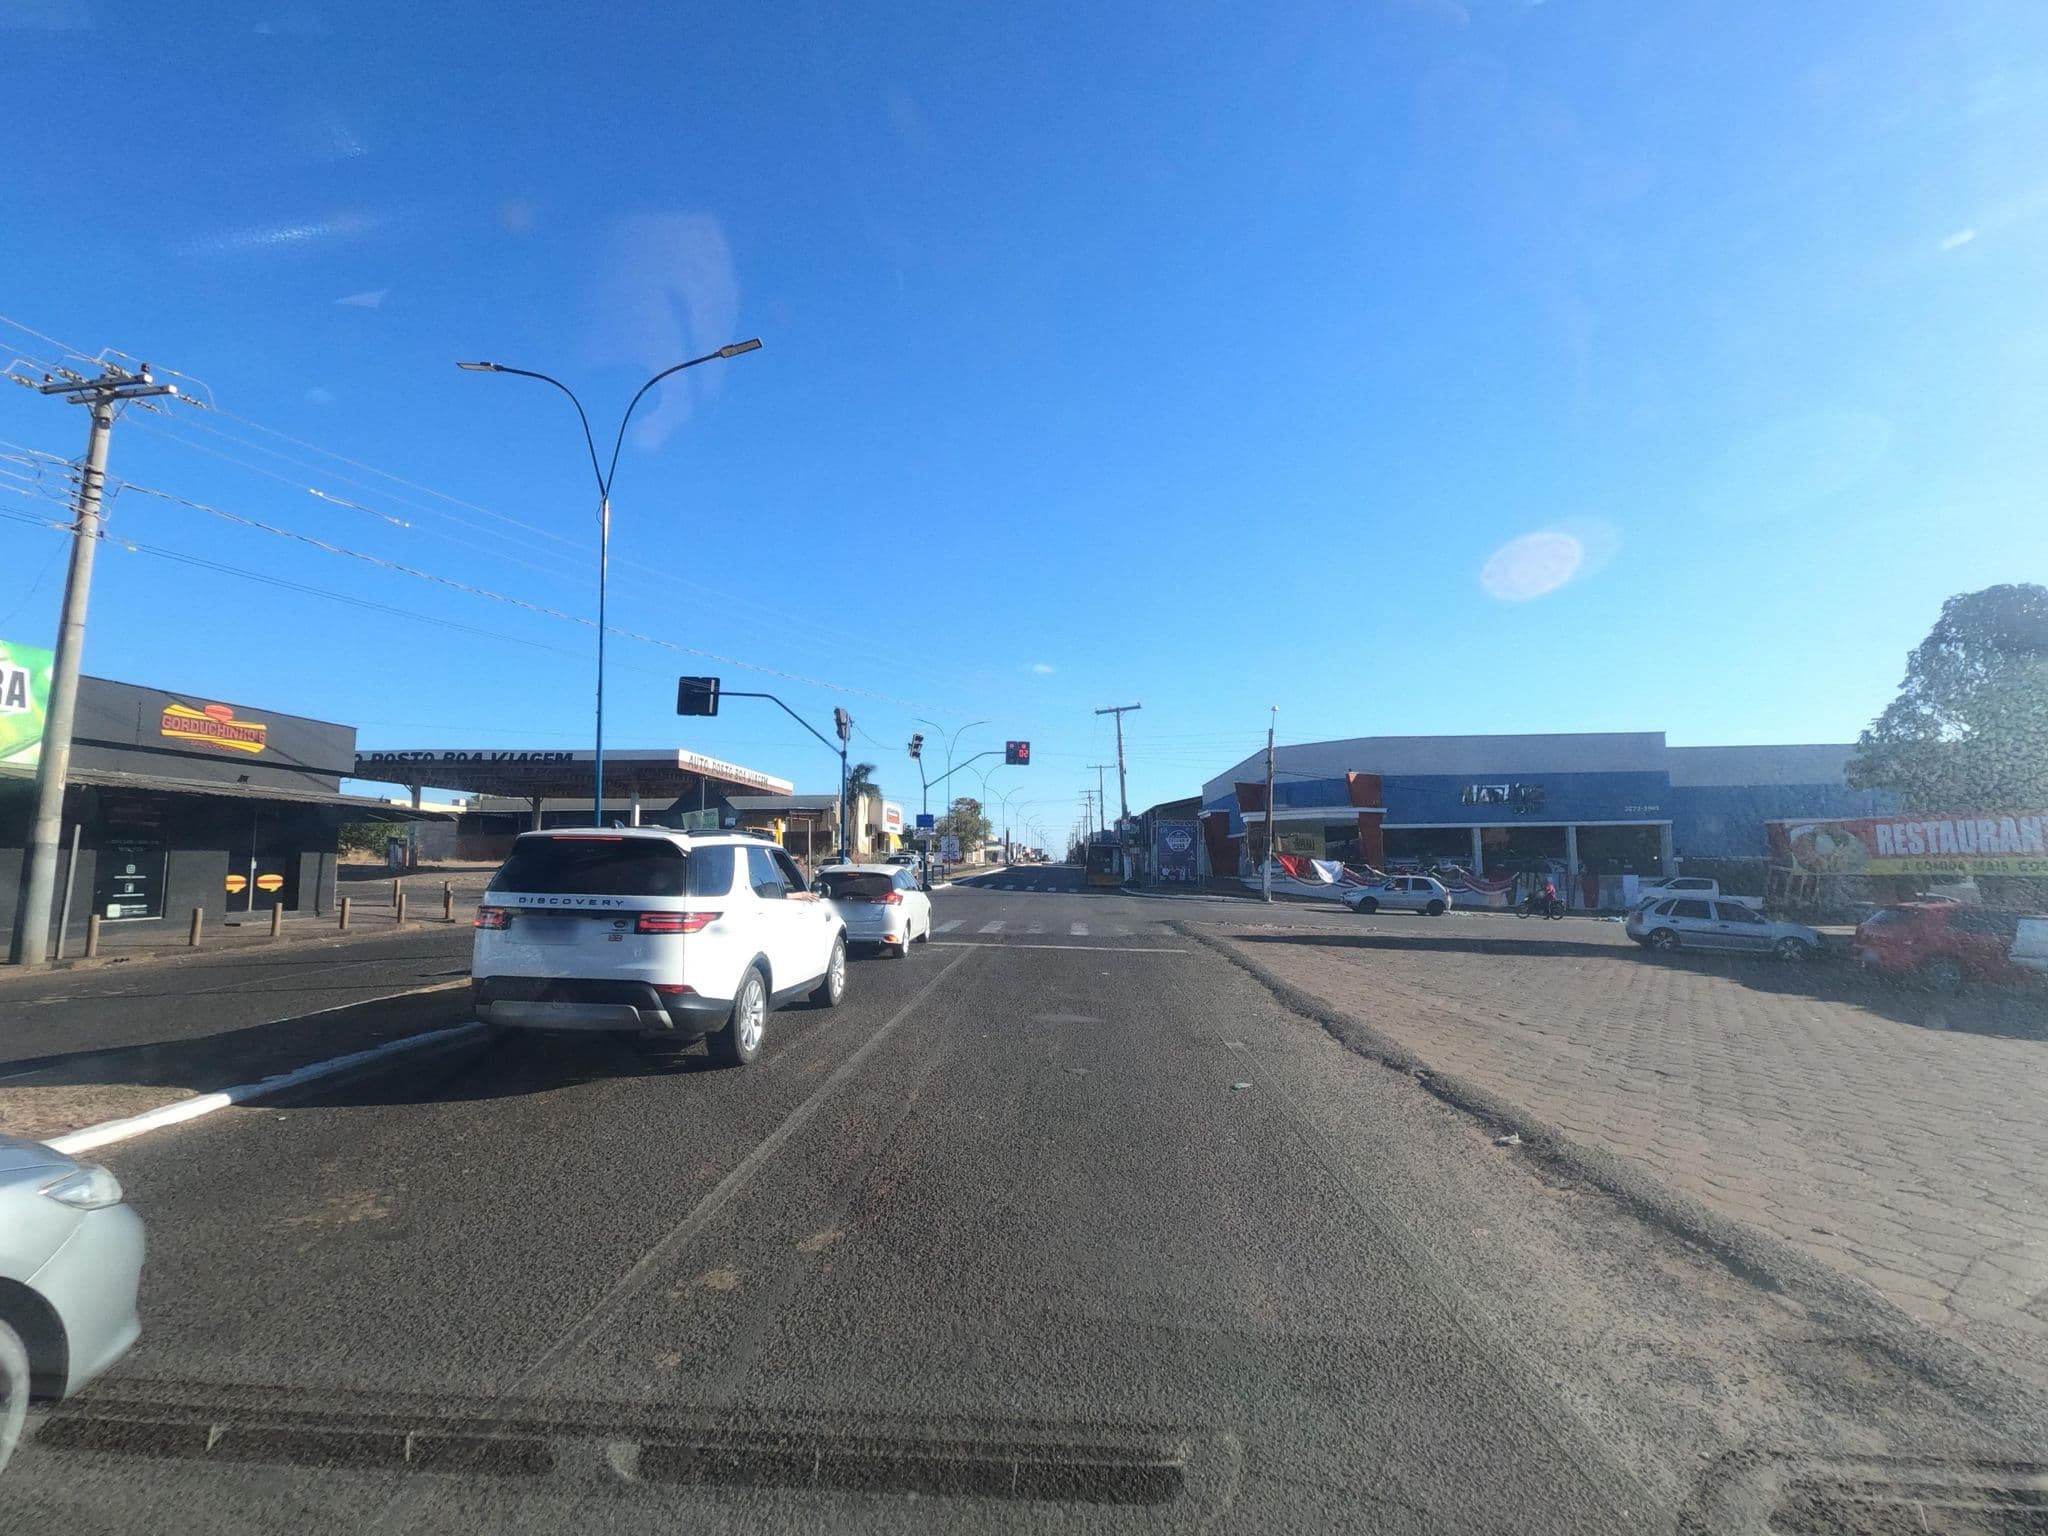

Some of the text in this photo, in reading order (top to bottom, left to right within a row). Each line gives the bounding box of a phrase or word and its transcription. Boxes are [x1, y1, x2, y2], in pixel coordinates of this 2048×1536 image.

[687, 754, 710, 772] AUTO
[711, 761, 733, 778] POSTO
[518, 896, 626, 907] DISCOVERY
